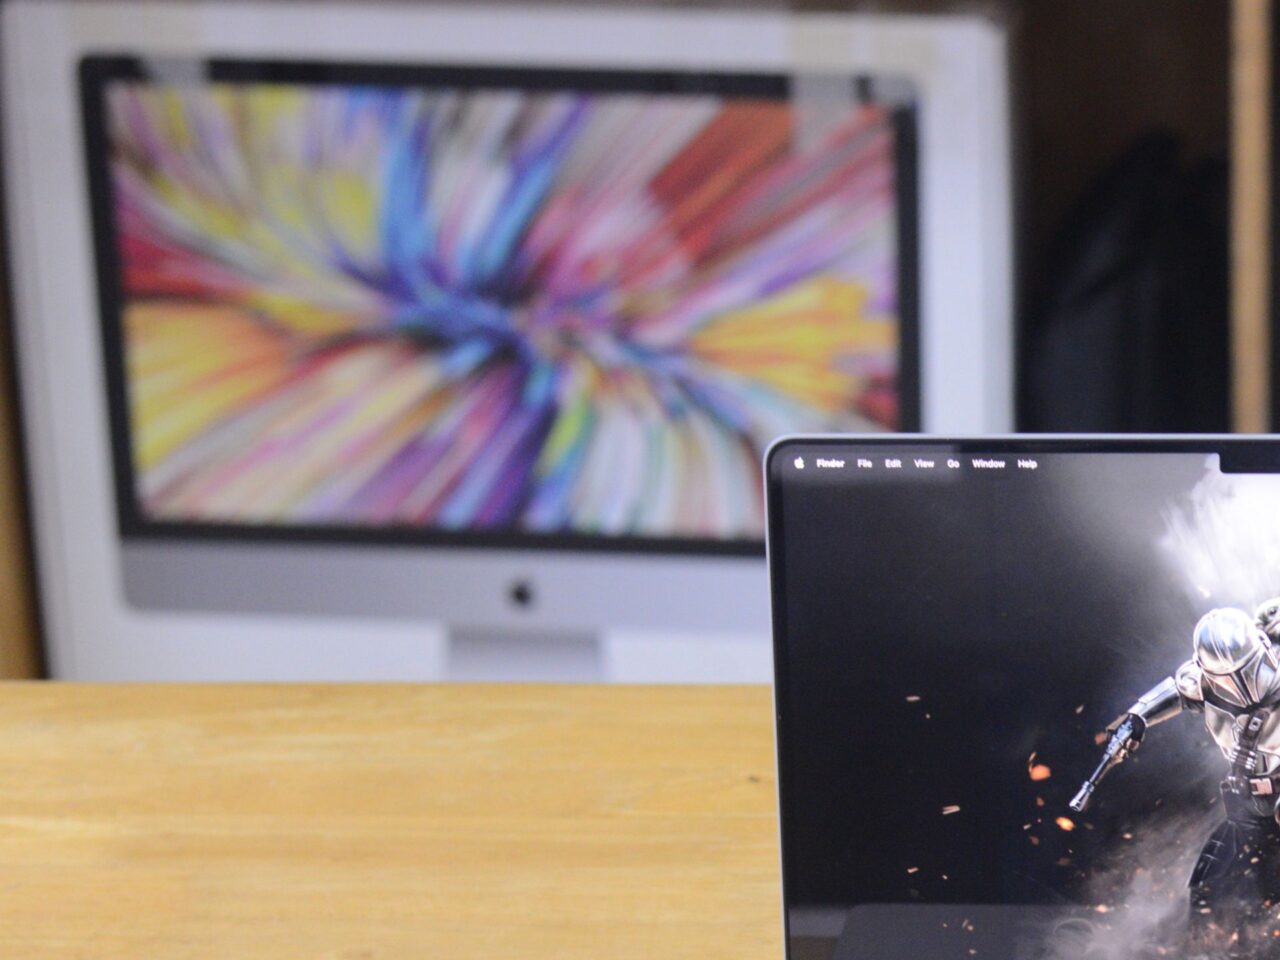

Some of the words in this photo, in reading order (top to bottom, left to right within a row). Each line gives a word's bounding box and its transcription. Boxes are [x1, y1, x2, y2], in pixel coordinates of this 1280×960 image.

[816, 458, 846, 469] Finder
[857, 458, 873, 469] File
[884, 458, 902, 469] Edit
[913, 458, 935, 469] View
[946, 458, 961, 469] Go
[971, 458, 1006, 469] Window
[1017, 459, 1038, 470] Help
